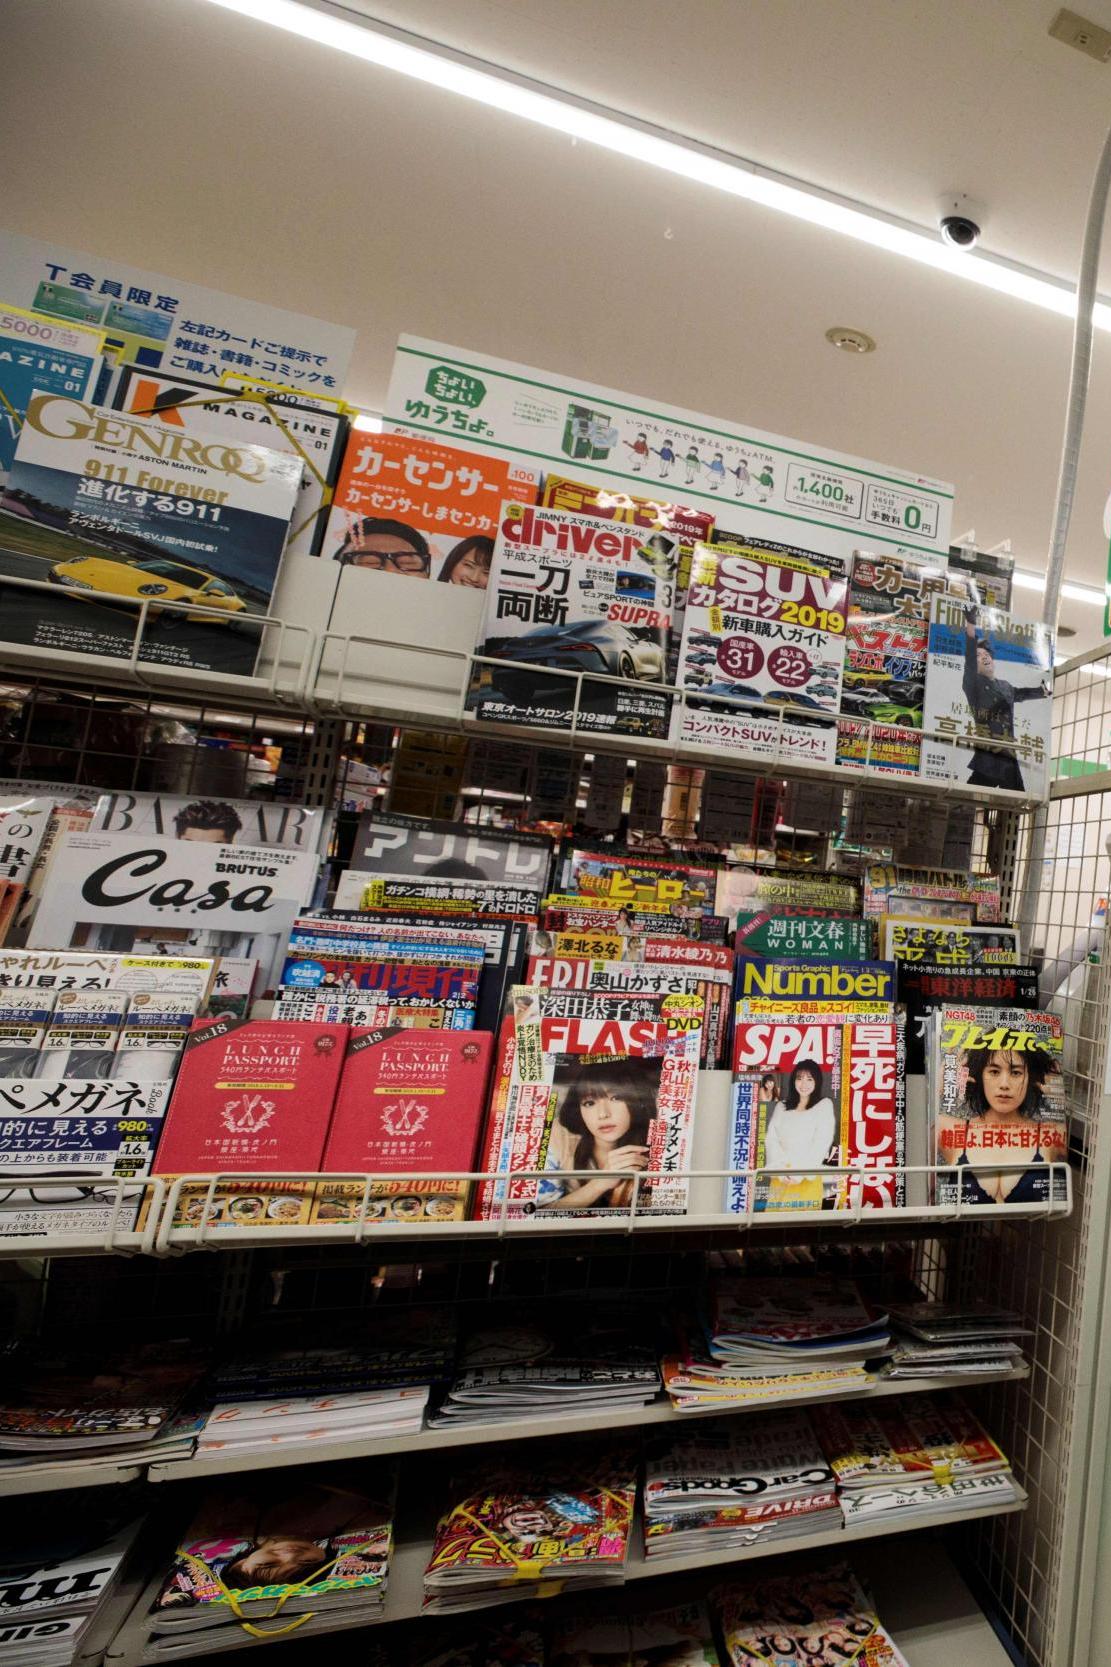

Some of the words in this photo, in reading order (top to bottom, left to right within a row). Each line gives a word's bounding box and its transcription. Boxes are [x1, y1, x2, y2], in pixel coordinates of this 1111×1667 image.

[45, 262, 181, 314] T会員限定
[179, 318, 328, 367] 左記カードご提示で
[174, 336, 337, 387] 雑誌・書籍・コミックを
[437, 369, 475, 389] ちょい
[203, 402, 333, 438] MAGAZINE
[405, 399, 495, 437] ゆうちょ。
[26, 394, 266, 484] GENROQ
[138, 454, 170, 468] ASTON
[171, 462, 208, 475] MARTIN
[353, 446, 499, 496] カーセンサー
[85, 458, 126, 484] 911
[137, 470, 230, 506] Forever
[77, 478, 222, 523] 進化する911
[535, 512, 568, 523] JIMNY
[871, 510, 901, 525] 手数料
[904, 504, 921, 530] 0
[922, 523, 932, 534] 円
[501, 508, 645, 562] driver
[502, 549, 573, 568] 平成スポーツ
[500, 565, 571, 596] 一刀
[719, 557, 847, 611] SUV
[496, 588, 570, 628] 両断
[607, 604, 672, 629] SUPRA
[693, 586, 845, 633] カタログ2019
[722, 615, 829, 648] 新車購入ガイド
[730, 638, 755, 650] 国産車
[779, 648, 803, 659] 輸入車
[726, 649, 754, 672] 31
[775, 657, 804, 680] 22
[101, 793, 307, 846] BAAR
[364, 823, 542, 877] アントレ
[81, 848, 275, 914] Casa
[215, 863, 279, 878] BRUTUS
[609, 870, 706, 900] ヒーロー
[767, 918, 846, 939] 週刊文春
[557, 938, 619, 956] 澤北るな
[767, 938, 844, 951] WOMAN
[182, 961, 201, 970] 980
[773, 963, 799, 973] Sports
[800, 964, 831, 974] Graphic
[589, 971, 684, 994] 奥山かずさ
[743, 961, 892, 998] Number
[541, 997, 631, 1021] 深田恭子
[945, 1010, 976, 1022] NGT48
[193, 1022, 229, 1044] Vol.18
[666, 1017, 702, 1031] DVD
[226, 1044, 301, 1056] LUNCH
[351, 1031, 384, 1051] Vol.18
[739, 1025, 837, 1066] SPA!
[223, 1055, 300, 1066] PASSPORT
[380, 1061, 450, 1072] PASSPORT
[382, 1052, 452, 1063] LUNCH
[117, 1121, 147, 1132] 980
[124, 1144, 142, 1156] 1.6
[941, 1129, 1066, 1149] 韓国よ、日本に甘えるな!
[0, 1152, 109, 1164] の上からも装着可能
[745, 1493, 832, 1520] DRIVE
